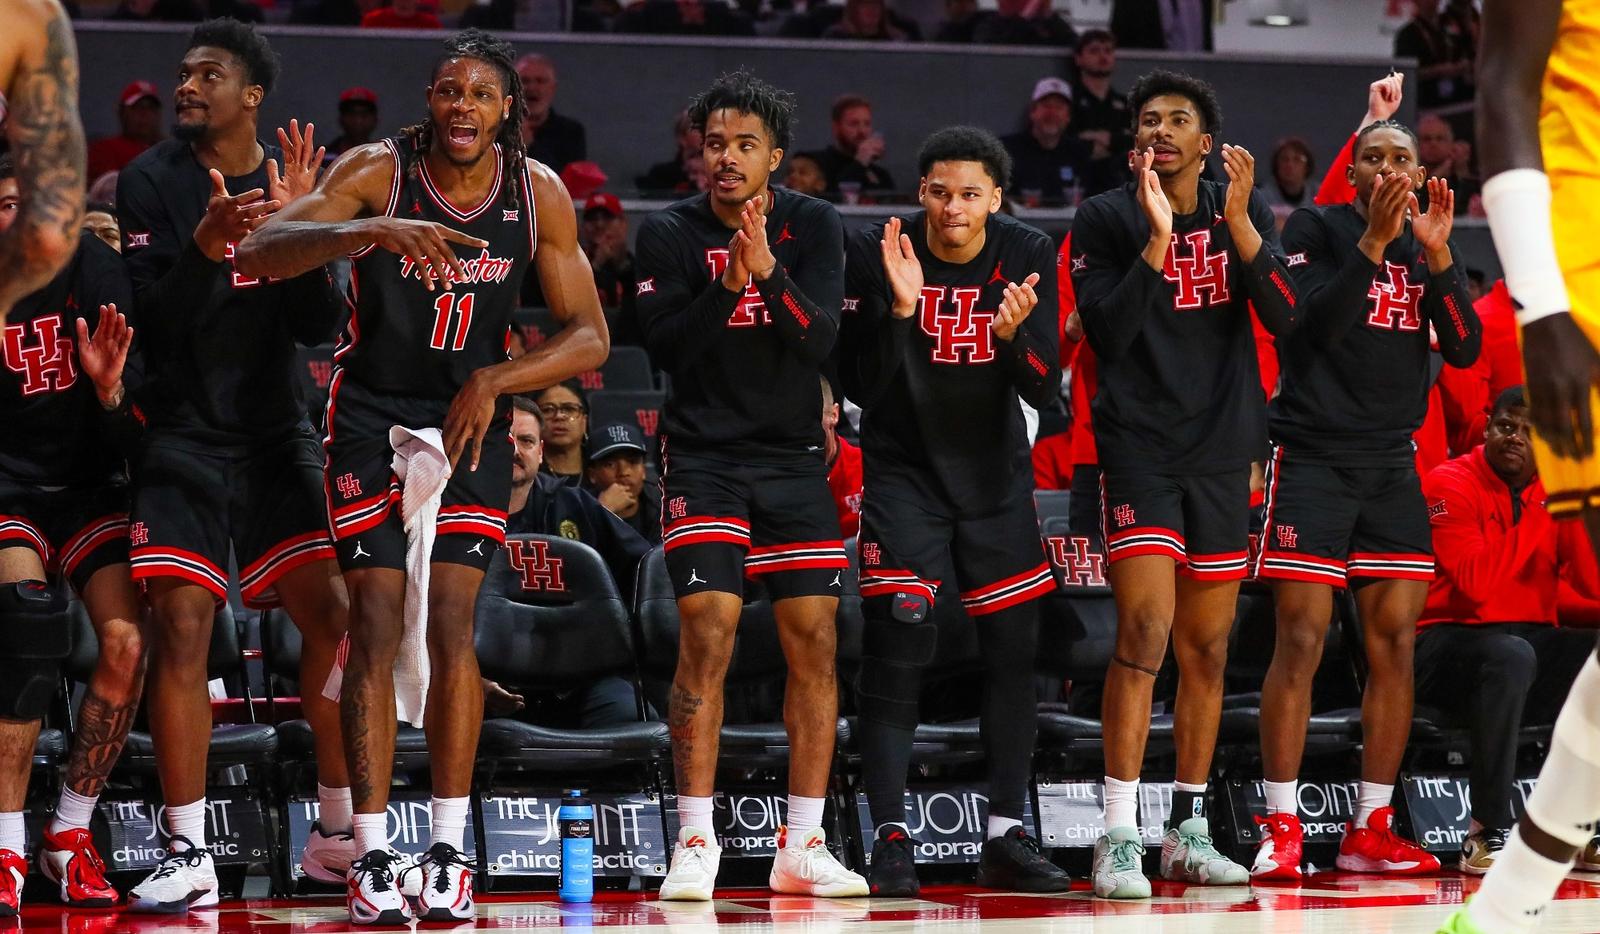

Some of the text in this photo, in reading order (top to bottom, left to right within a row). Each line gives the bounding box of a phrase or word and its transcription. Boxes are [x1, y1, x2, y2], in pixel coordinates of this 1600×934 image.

[1162, 229, 1230, 309] UH
[430, 292, 475, 351] 11
[918, 286, 996, 365] UH
[3, 315, 77, 395] UH
[336, 473, 362, 498] UH
[669, 496, 687, 518] UH
[1113, 504, 1136, 527] UH
[1276, 525, 1298, 548] UH
[505, 540, 565, 592] UH
[863, 543, 881, 565] UH
[1048, 537, 1108, 587] UH
[1411, 777, 1455, 798] THE
[106, 800, 147, 820] THE
[494, 797, 645, 846] THE JINT
[496, 849, 650, 869] chiroactic
